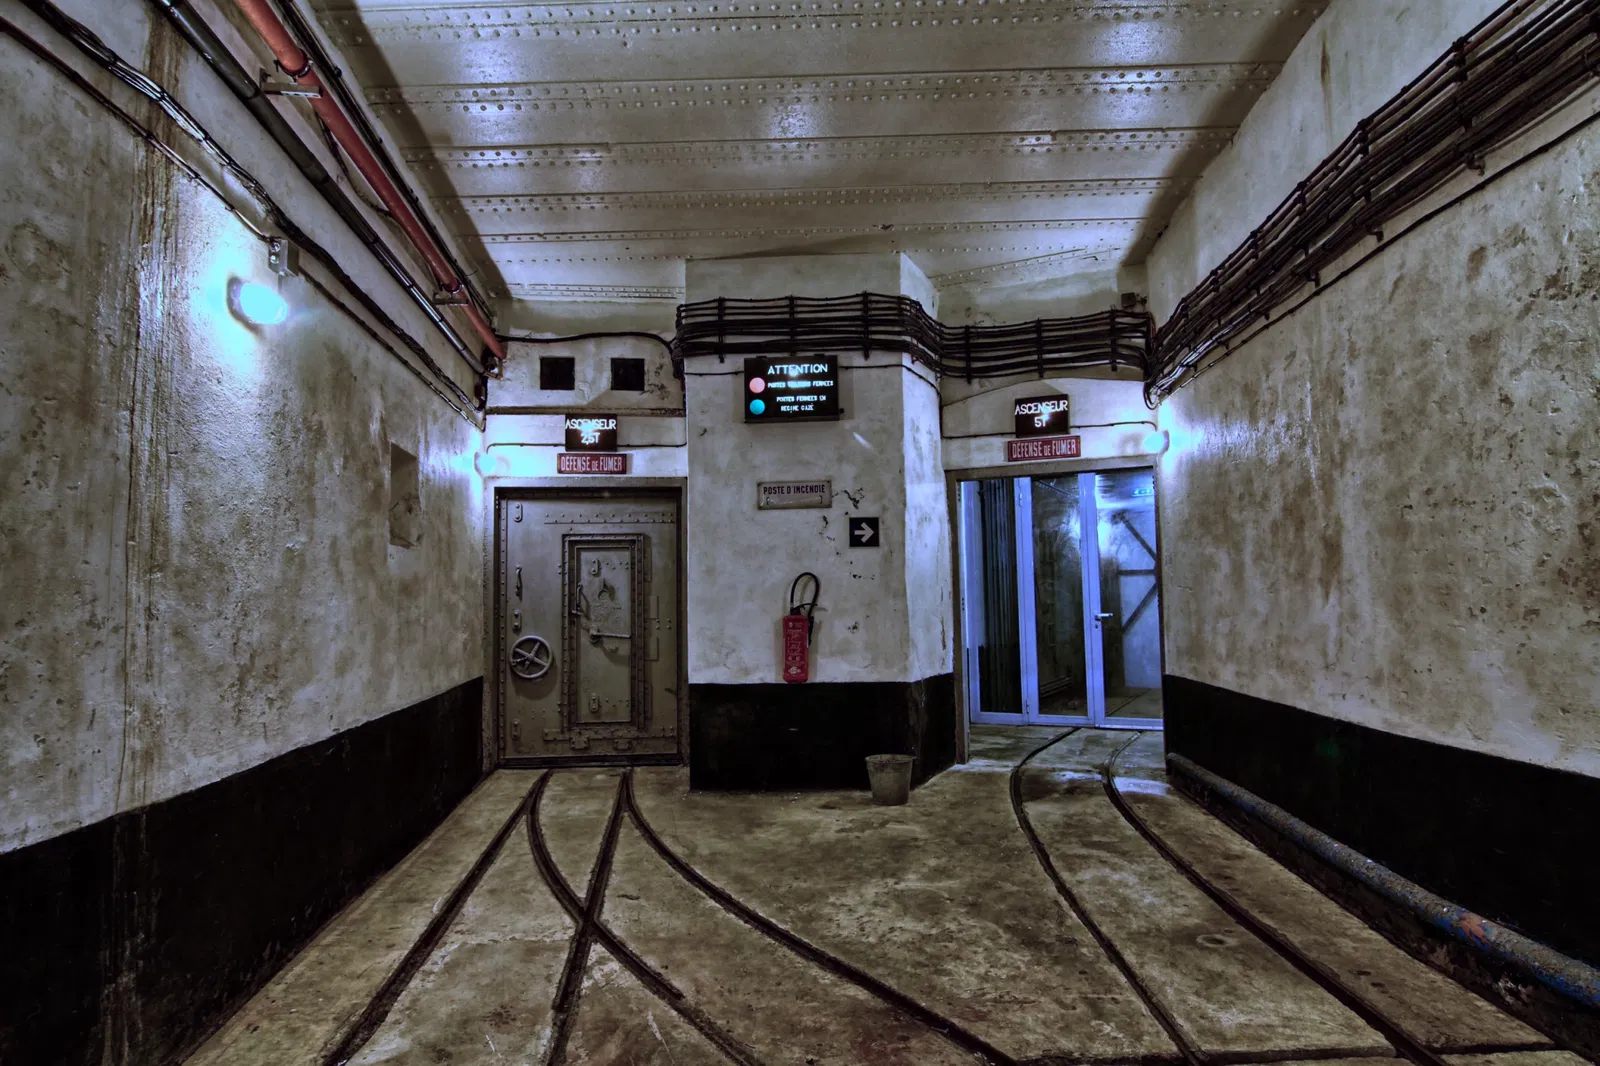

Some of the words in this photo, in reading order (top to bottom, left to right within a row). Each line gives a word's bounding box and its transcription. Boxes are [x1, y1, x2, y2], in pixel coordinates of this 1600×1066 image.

[767, 364, 828, 376] ATTENTION
[1015, 400, 1068, 415] ASCENSEUR
[565, 419, 617, 430] ASCENSEUR
[1034, 415, 1049, 428] 5T
[1044, 445, 1051, 456] DE
[1052, 439, 1077, 456] FUMER
[592, 460, 599, 471] DE
[600, 456, 623, 471] FUMER
[763, 486, 785, 495] POSTE
